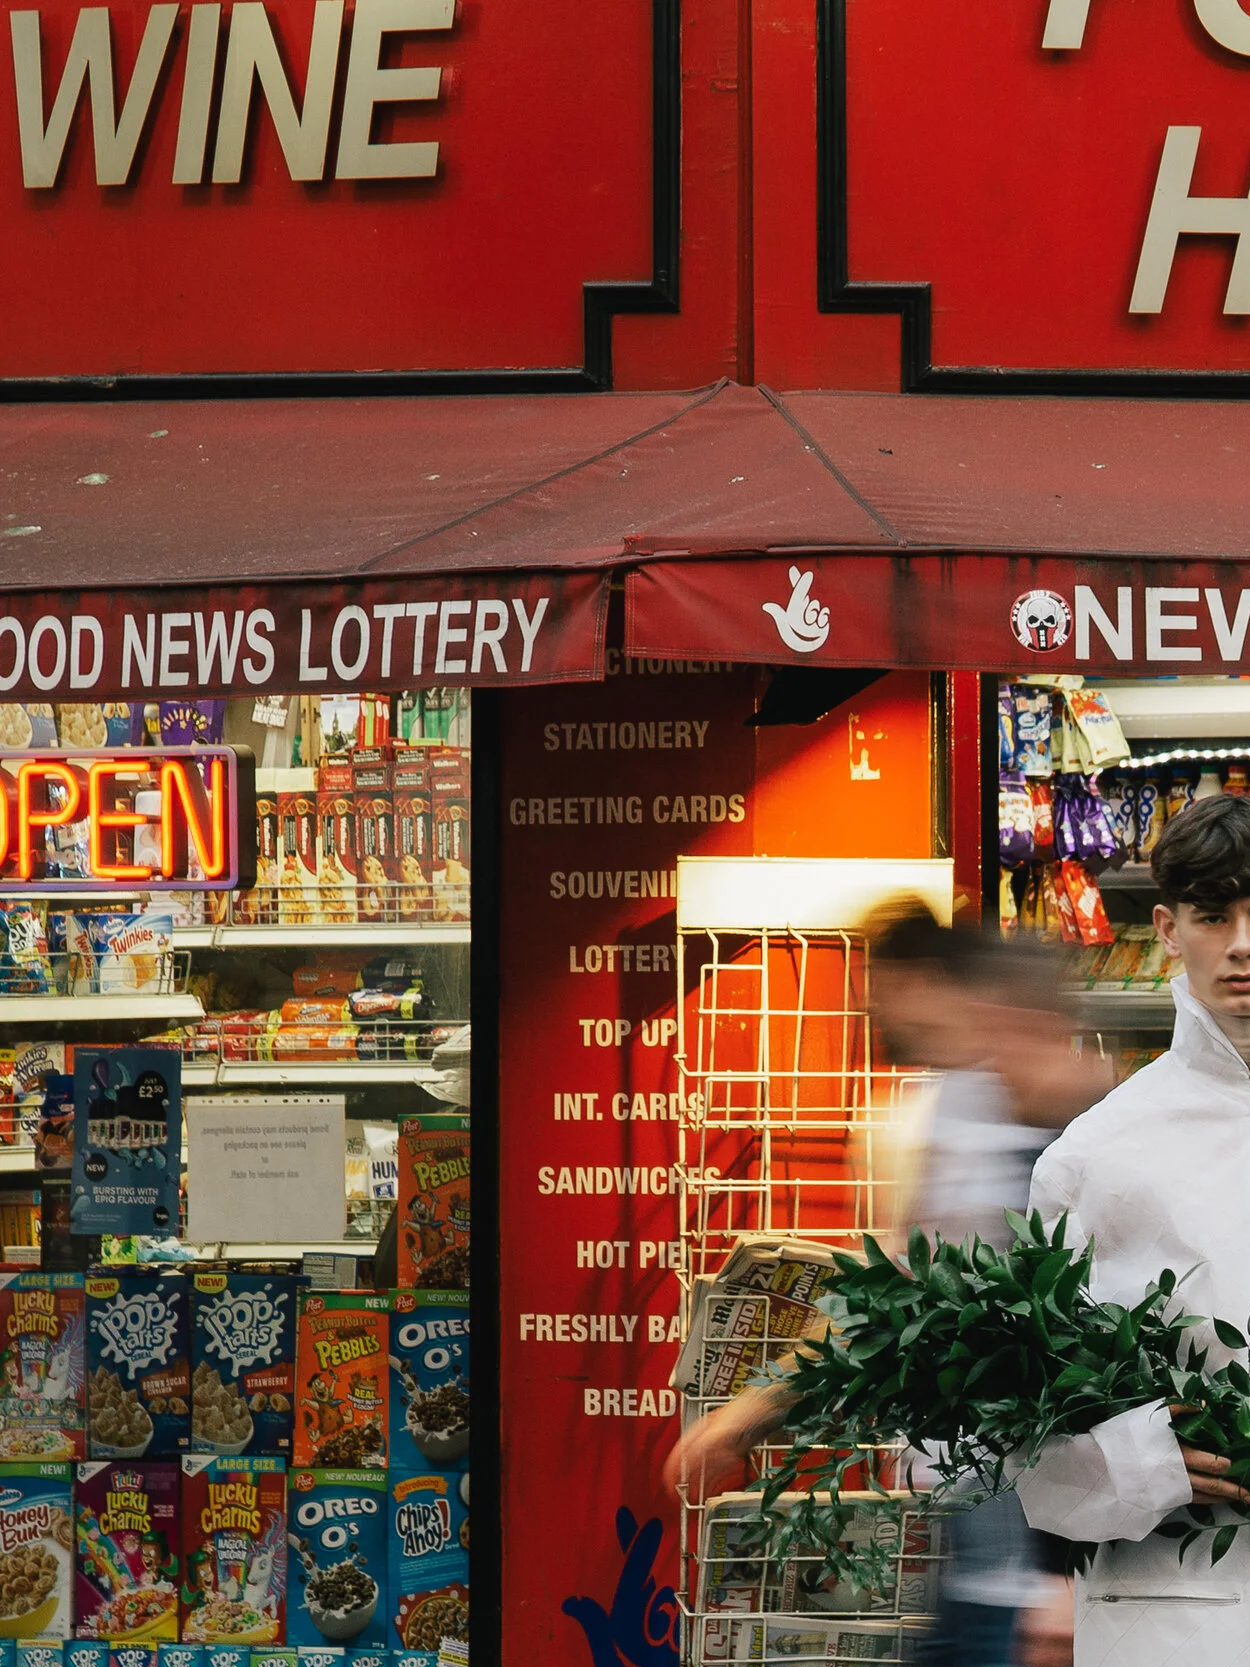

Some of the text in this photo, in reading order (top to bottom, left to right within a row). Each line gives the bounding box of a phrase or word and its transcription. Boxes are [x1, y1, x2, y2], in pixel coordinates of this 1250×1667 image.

[10, 0, 456, 189] WINE
[121, 608, 275, 688] NEWS
[300, 598, 549, 682] LOTTERY
[544, 721, 710, 750] STATIONERY
[0, 760, 224, 879] PEN
[509, 794, 746, 825] GREETING CARDS
[108, 925, 154, 961] Twinkies
[580, 1017, 678, 1047] TOP UP
[554, 1093, 603, 1121] INT.
[86, 1163, 106, 1173] NEW
[538, 1166, 721, 1195] SANDWICHES
[92, 1186, 159, 1196] BURSTING WITH
[117, 1196, 156, 1205] FLAVOUR
[576, 1241, 630, 1269] HOT
[88, 1281, 117, 1293] NEW!
[197, 1275, 224, 1288] NEW!
[792, 1262, 820, 1304] POINTS
[365, 1298, 389, 1309] NEW
[519, 1314, 635, 1342] FRESHLY
[246, 1376, 288, 1389] STRAWBERRY
[584, 1388, 677, 1416] BREAD
[39, 1464, 66, 1475] NEW!
[216, 1458, 249, 1472] LARGE
[296, 1496, 379, 1528] OREO
[397, 1502, 440, 1537] Chips
